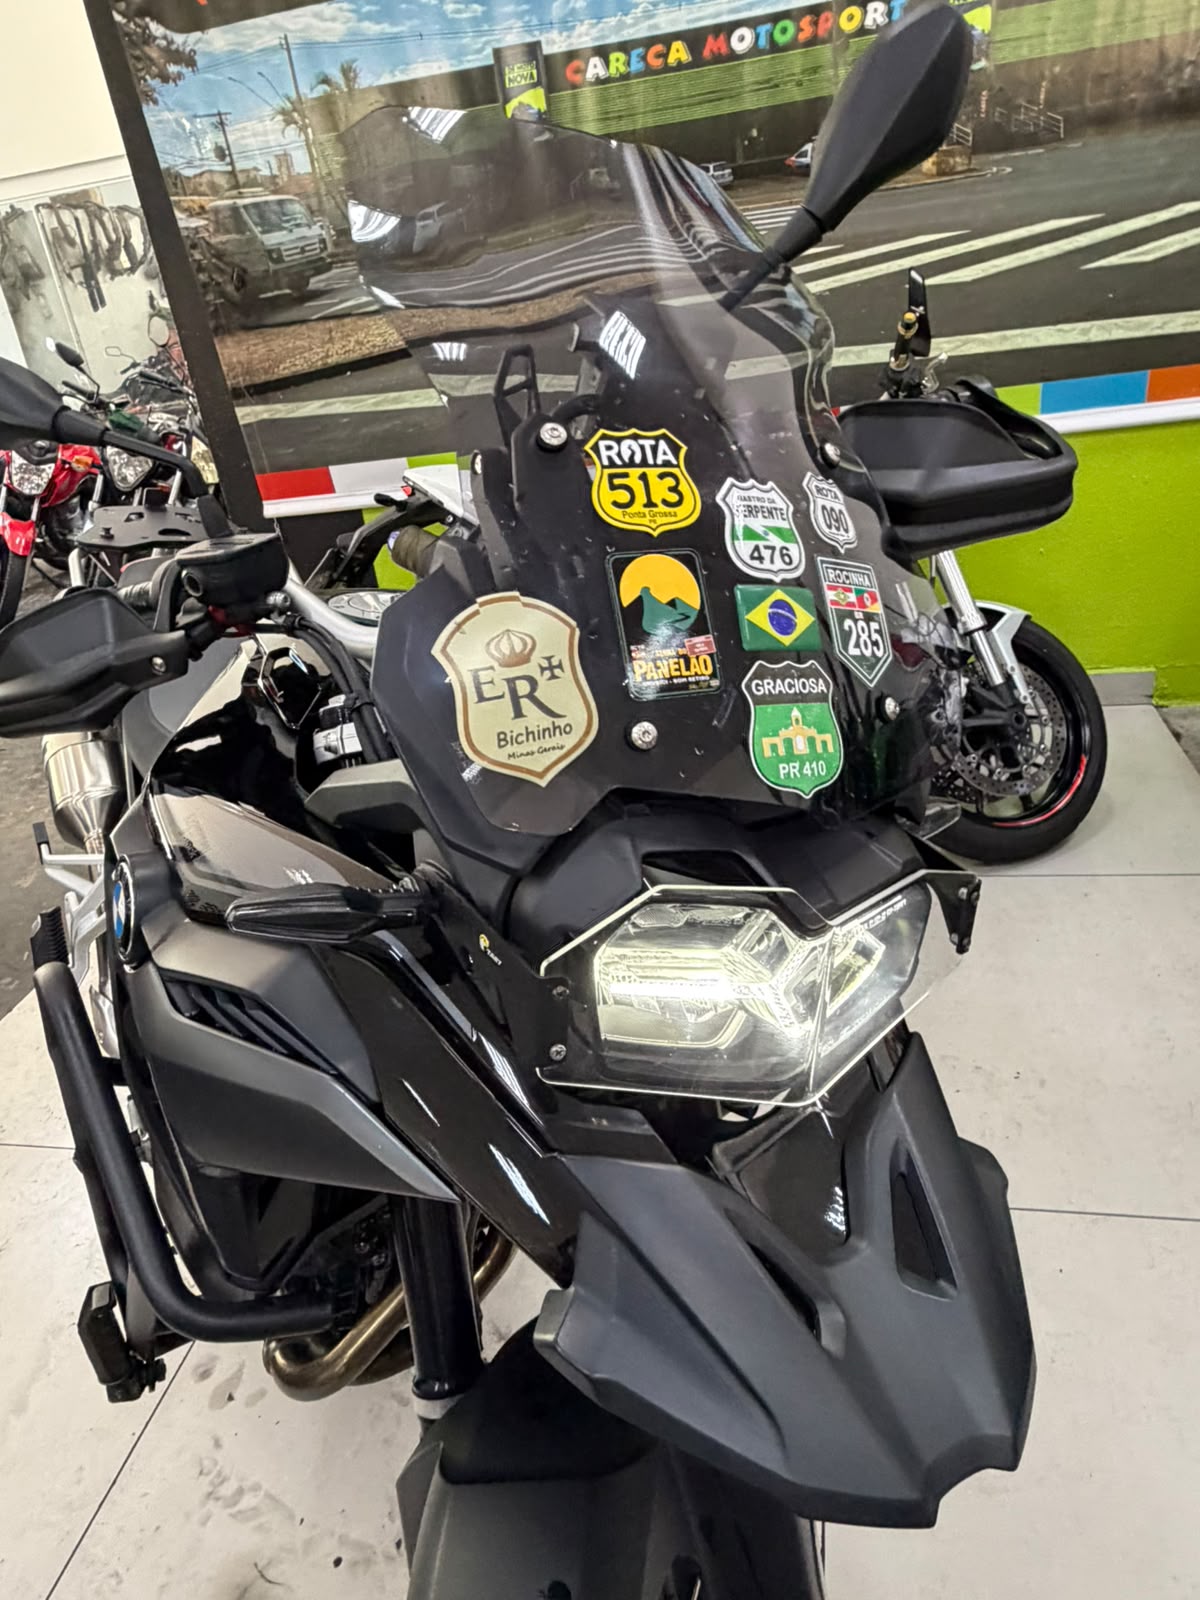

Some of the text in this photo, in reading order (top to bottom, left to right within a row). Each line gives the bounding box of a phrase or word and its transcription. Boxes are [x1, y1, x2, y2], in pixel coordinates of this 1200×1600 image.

[565, 0, 907, 85] CARECA MOTOSPORT
[508, 71, 535, 86] NOVA
[598, 438, 678, 466] ROTA
[607, 471, 684, 511] 513
[814, 485, 840, 501] ROTA
[622, 509, 677, 519] Ponta Grossa
[821, 504, 849, 534] 090
[749, 544, 793, 566] 476
[827, 569, 871, 588] ROCINHA
[843, 618, 884, 658] 285
[751, 677, 828, 695] GRACIOSA
[496, 721, 573, 749] Bichinho
[507, 743, 567, 761] Minas Gerais
[779, 760, 826, 779] PR 410
